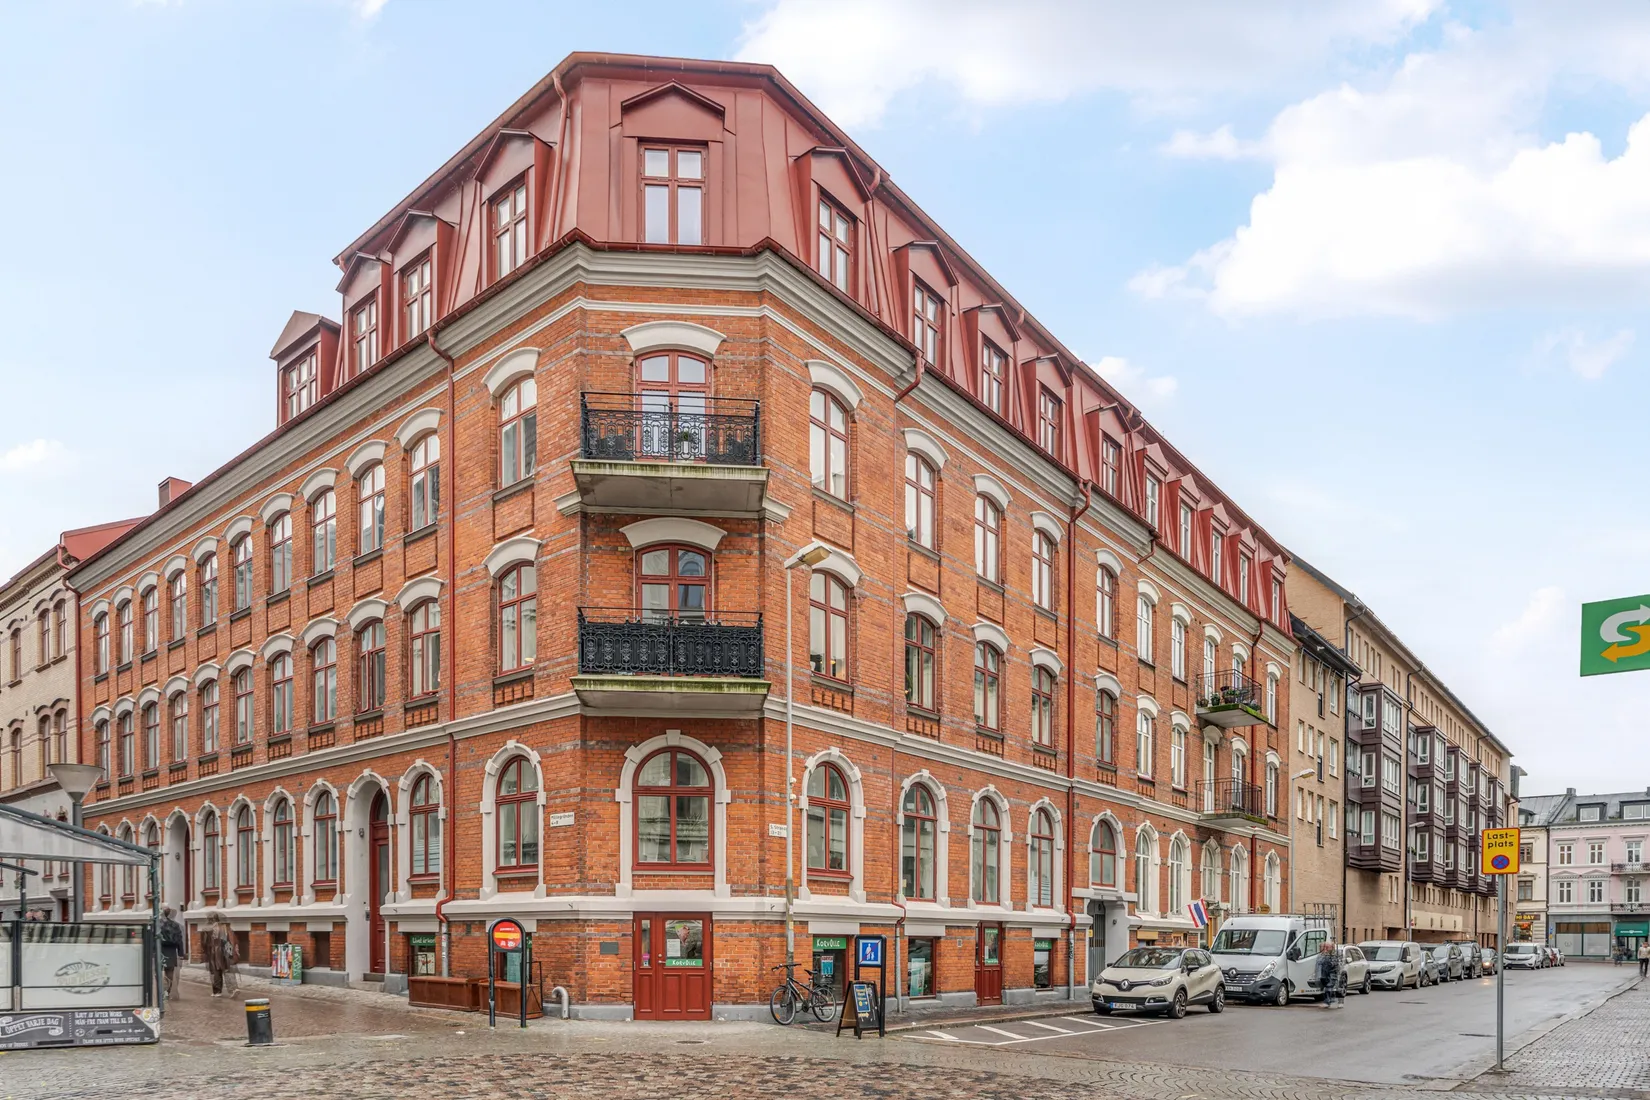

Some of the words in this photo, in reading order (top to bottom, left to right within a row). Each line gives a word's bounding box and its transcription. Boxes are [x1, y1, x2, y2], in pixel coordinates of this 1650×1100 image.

[1487, 832, 1515, 840] Last-
[1487, 840, 1514, 850] plats
[46, 1018, 60, 1026] DAG
